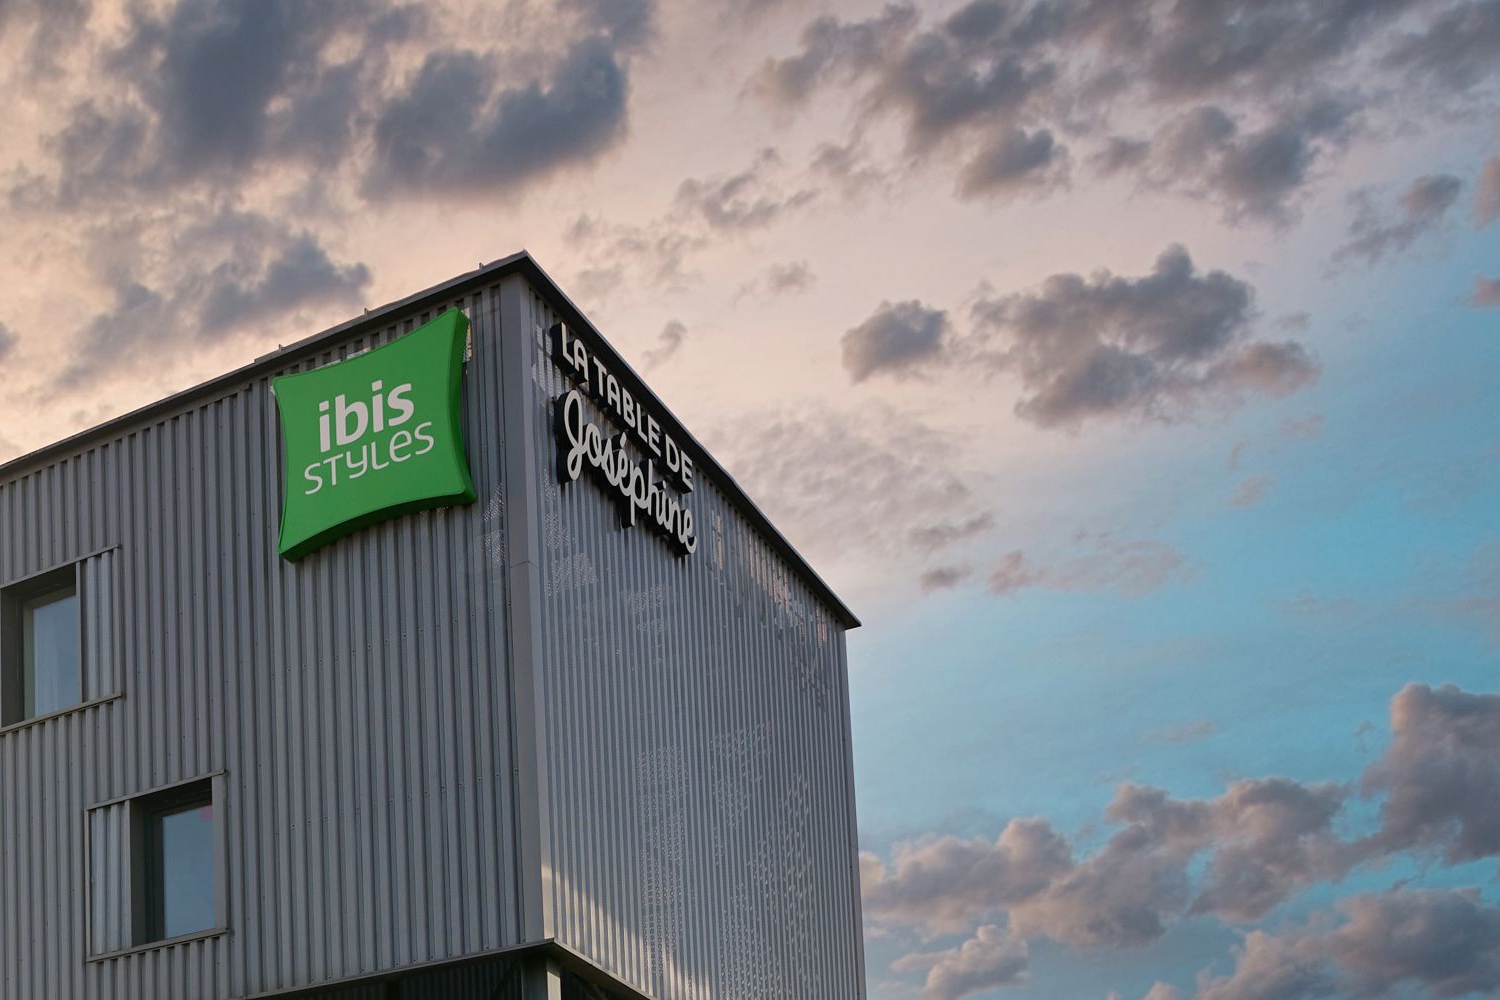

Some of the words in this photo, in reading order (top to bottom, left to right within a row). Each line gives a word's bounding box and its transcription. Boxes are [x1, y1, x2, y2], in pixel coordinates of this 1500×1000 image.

[318, 379, 415, 453] ibis
[561, 322, 589, 381] LA
[593, 356, 661, 457] TABLE
[665, 433, 693, 491] DE
[563, 389, 697, 554] Joséphine
